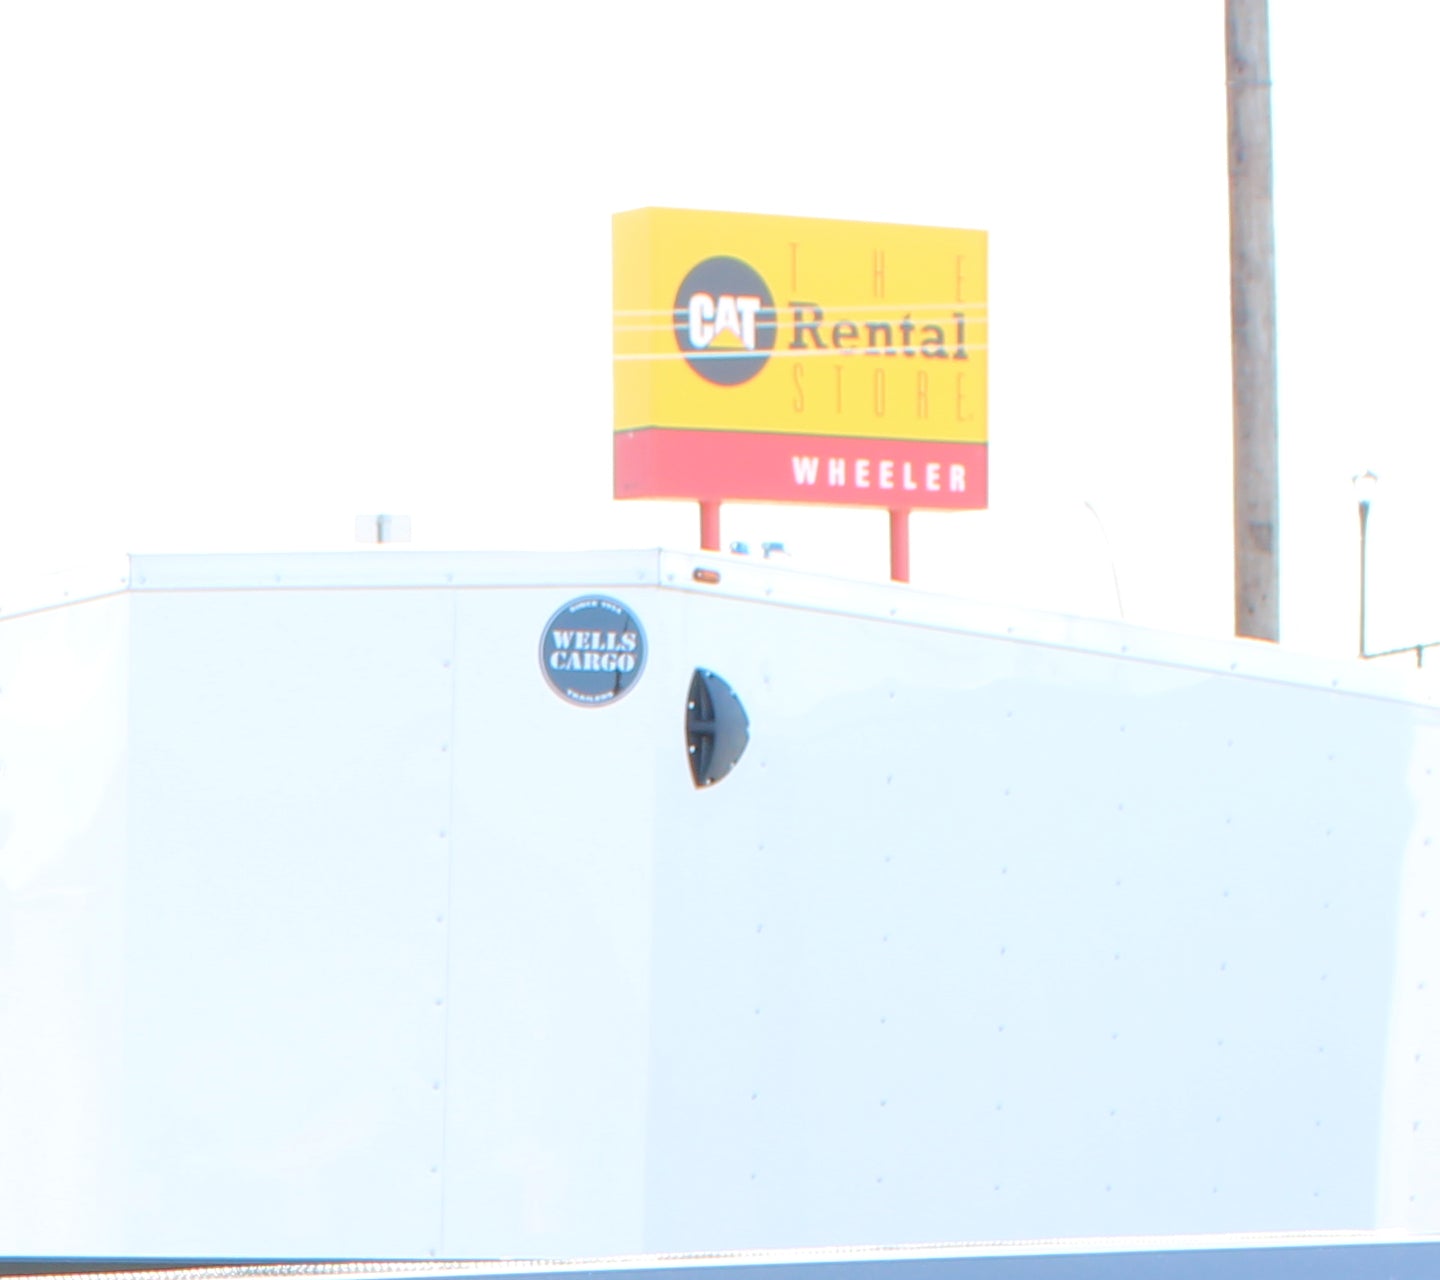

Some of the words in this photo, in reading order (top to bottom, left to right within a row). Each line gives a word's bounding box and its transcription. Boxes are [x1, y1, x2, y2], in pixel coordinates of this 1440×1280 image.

[688, 292, 761, 350] CAT
[787, 300, 970, 361] Rental
[791, 455, 967, 493] WHEELER
[552, 629, 637, 652] WELLS
[550, 651, 636, 673] CARGO
